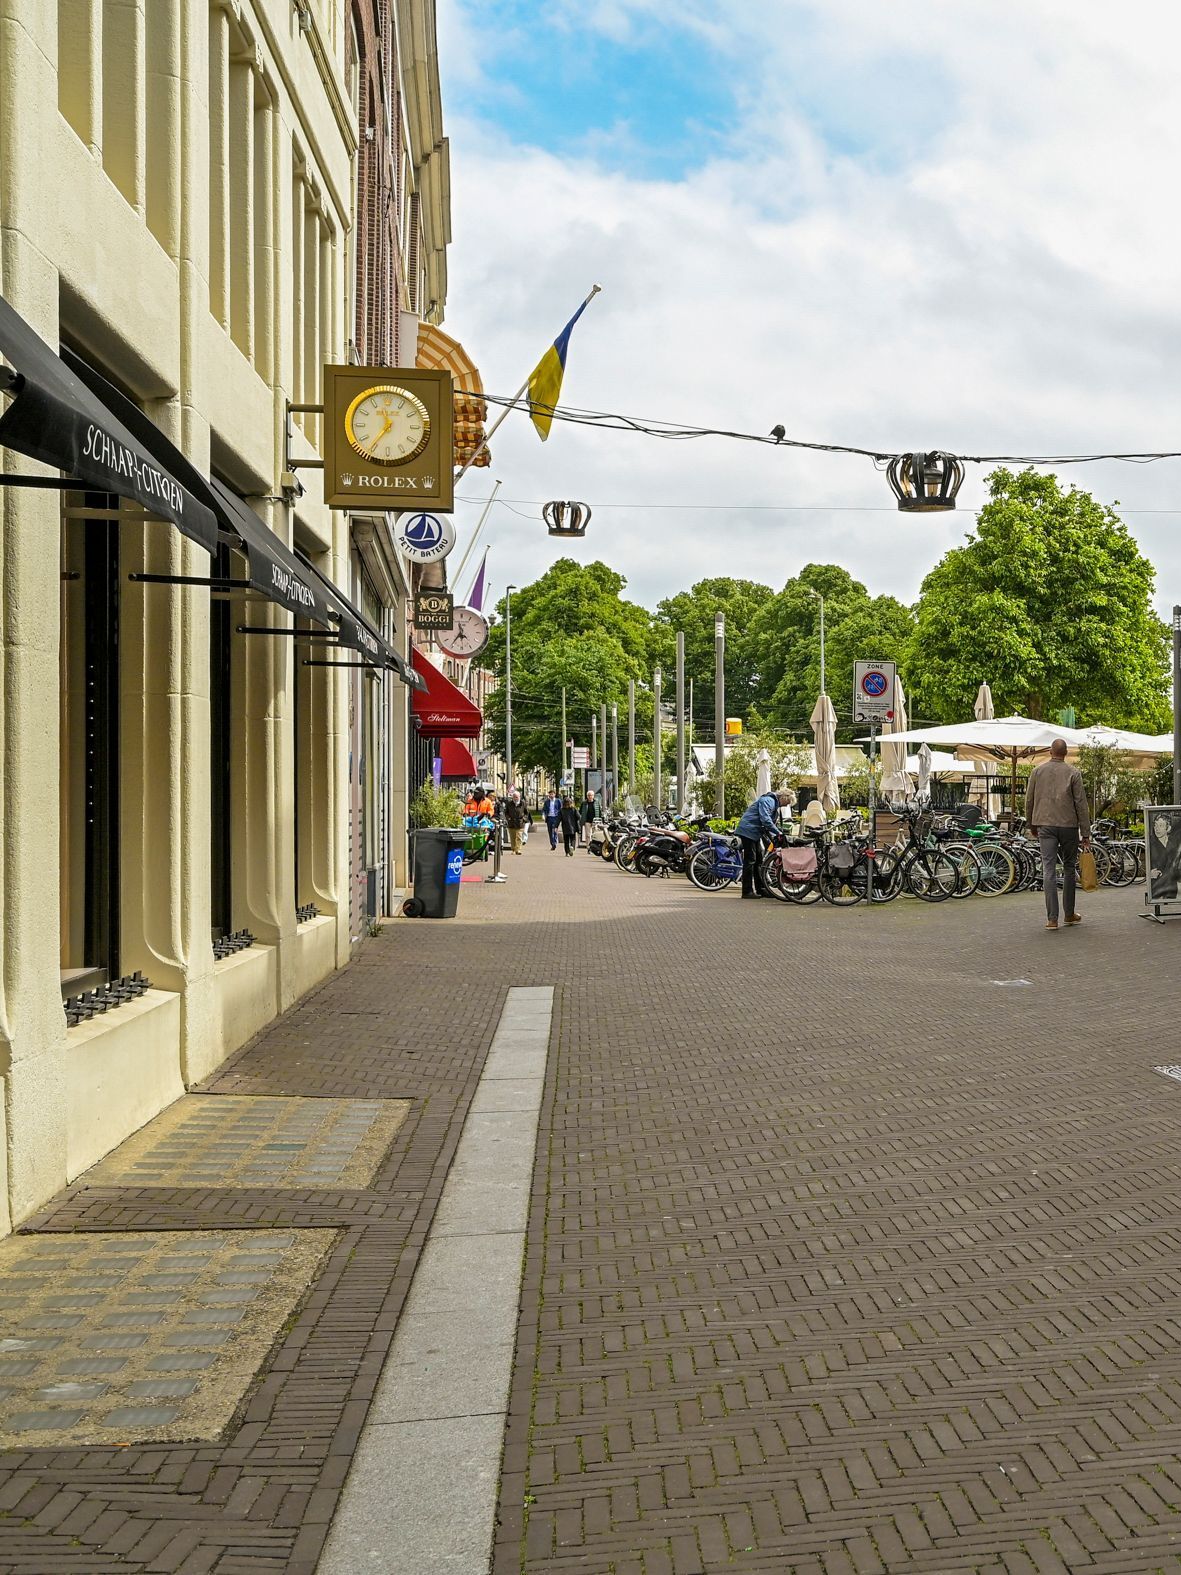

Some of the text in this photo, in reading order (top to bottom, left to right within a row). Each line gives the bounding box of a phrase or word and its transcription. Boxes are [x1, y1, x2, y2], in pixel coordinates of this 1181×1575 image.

[358, 475, 418, 489] ROLEX
[399, 536, 448, 558] PETIT BATEAU
[418, 615, 450, 623] BOGGI
